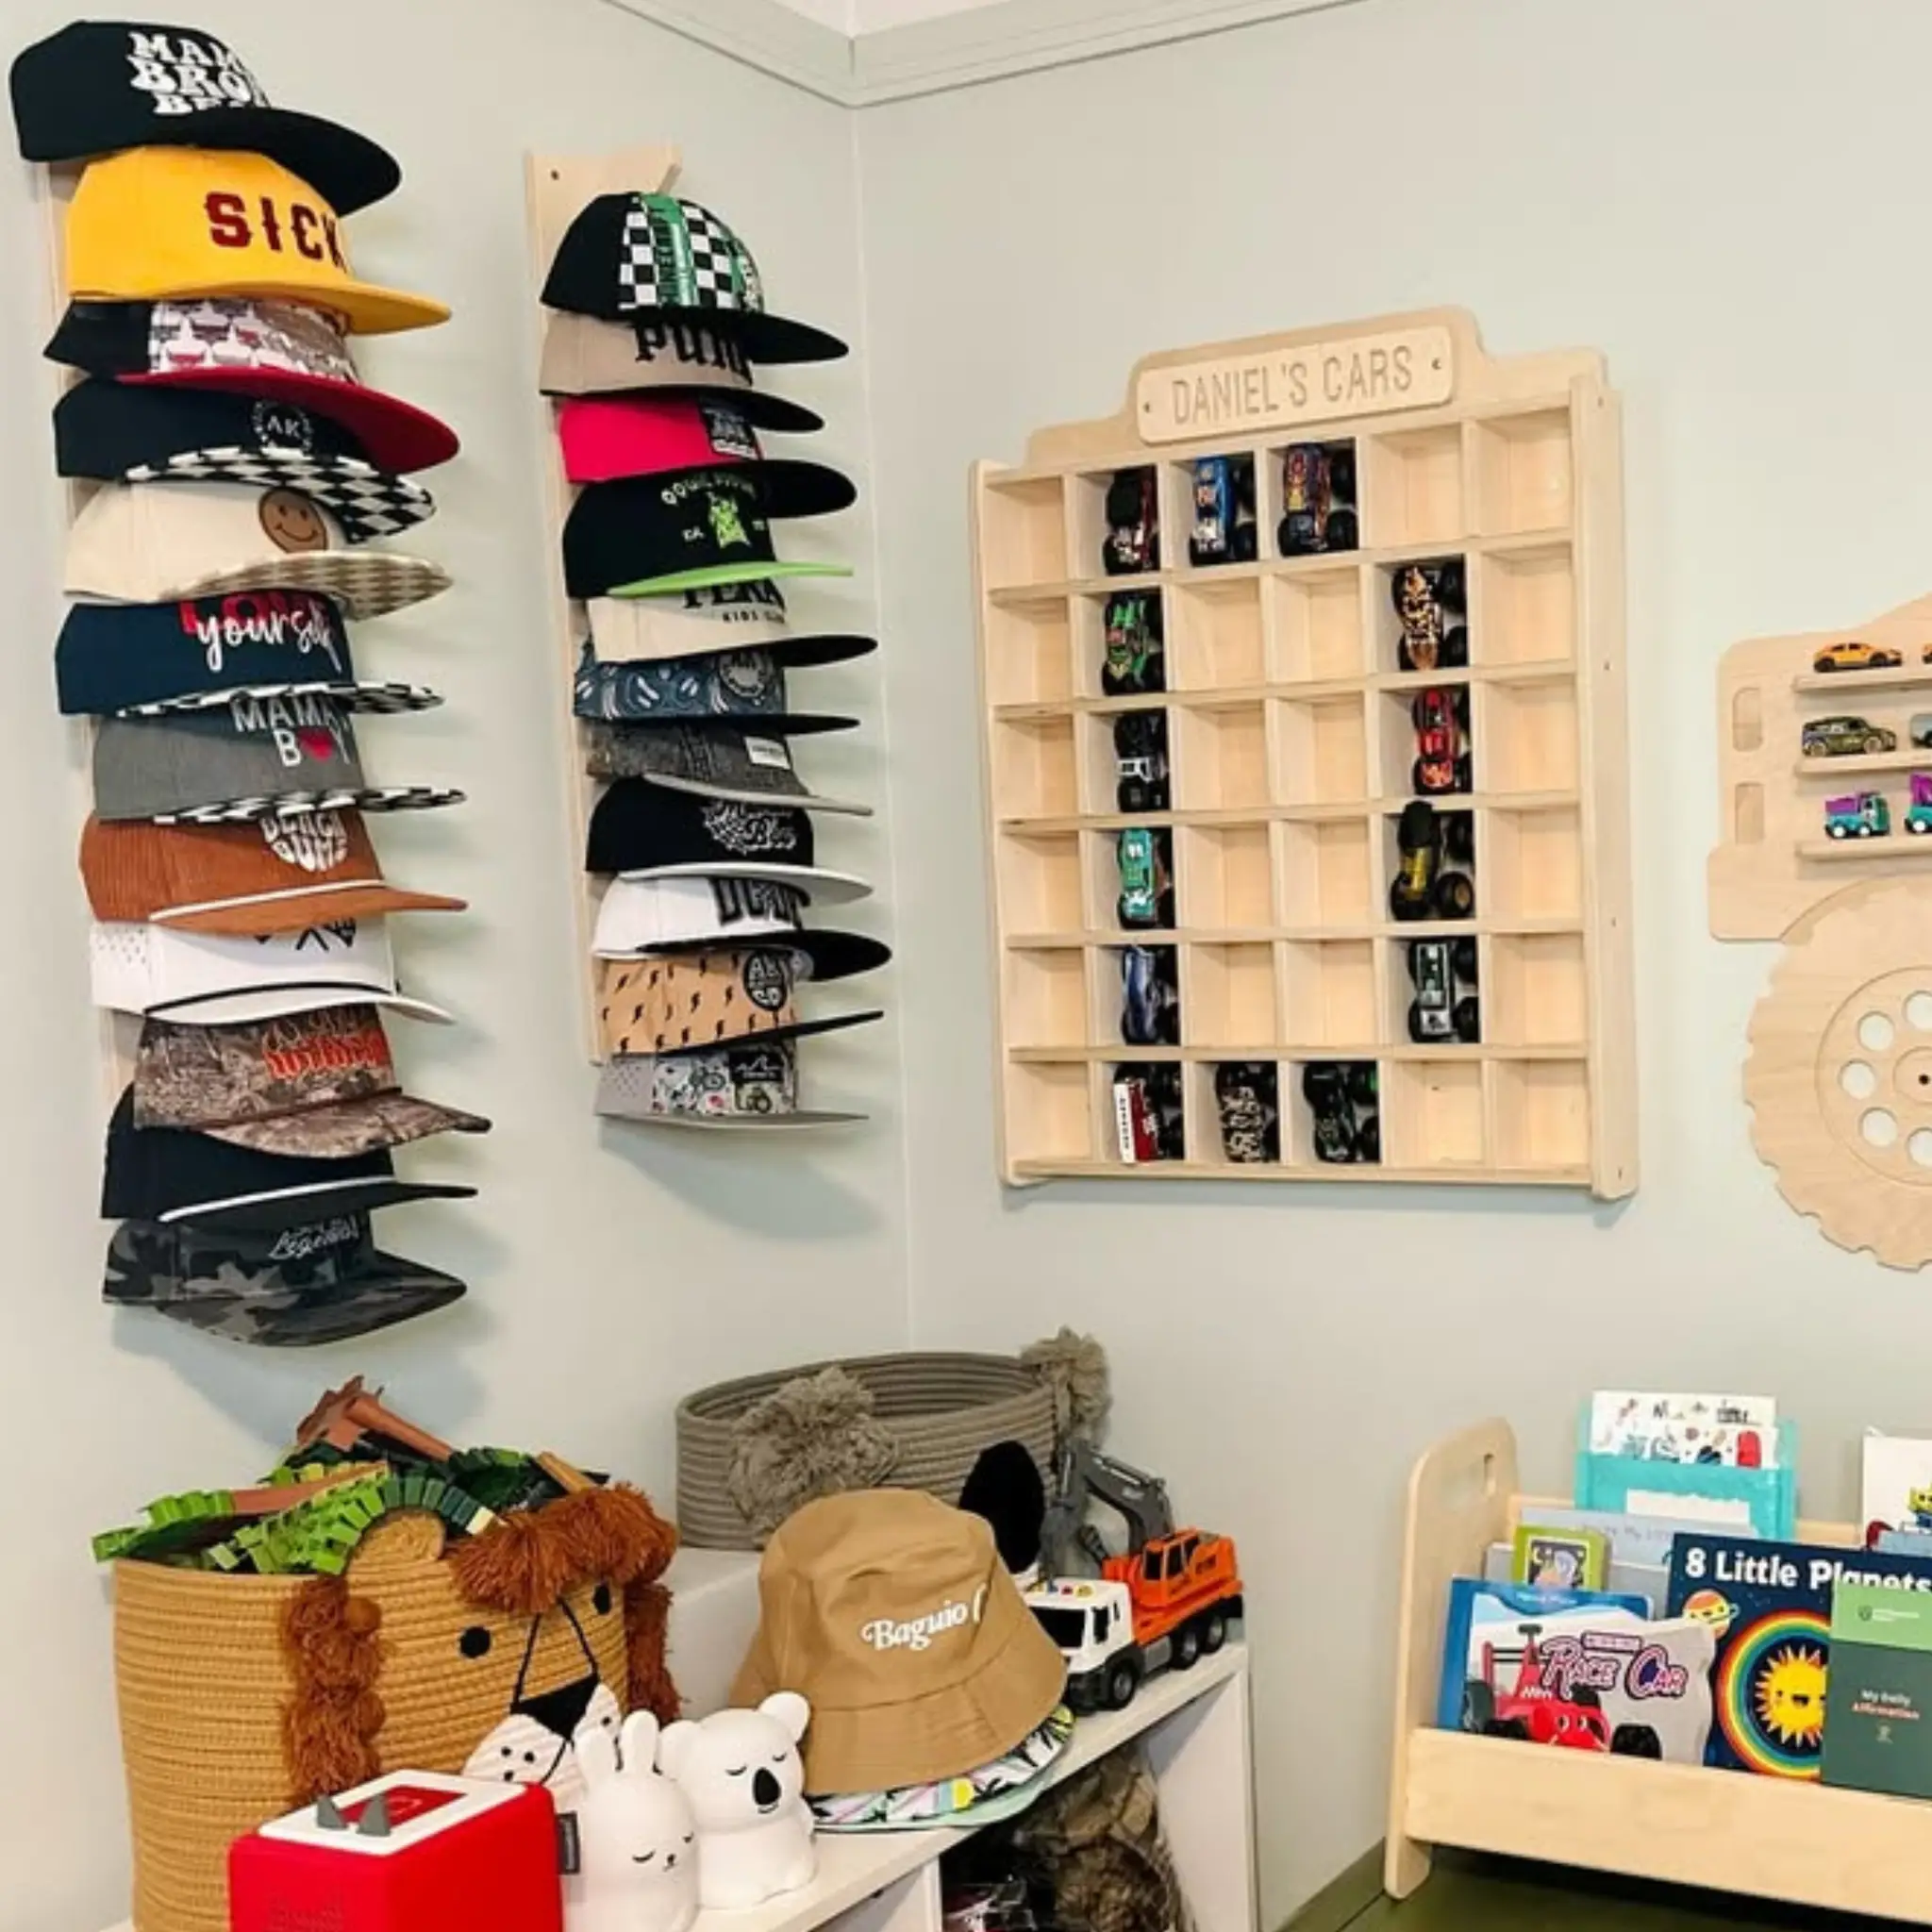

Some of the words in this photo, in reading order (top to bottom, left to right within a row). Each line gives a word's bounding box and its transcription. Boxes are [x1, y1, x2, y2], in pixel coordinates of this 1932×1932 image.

[1172, 361, 1308, 425] DANIEL'S
[1323, 345, 1412, 403] CARS
[1685, 1548, 1707, 1578] 8
[1715, 1550, 1800, 1588] Little
[860, 1599, 969, 1651] Baguio
